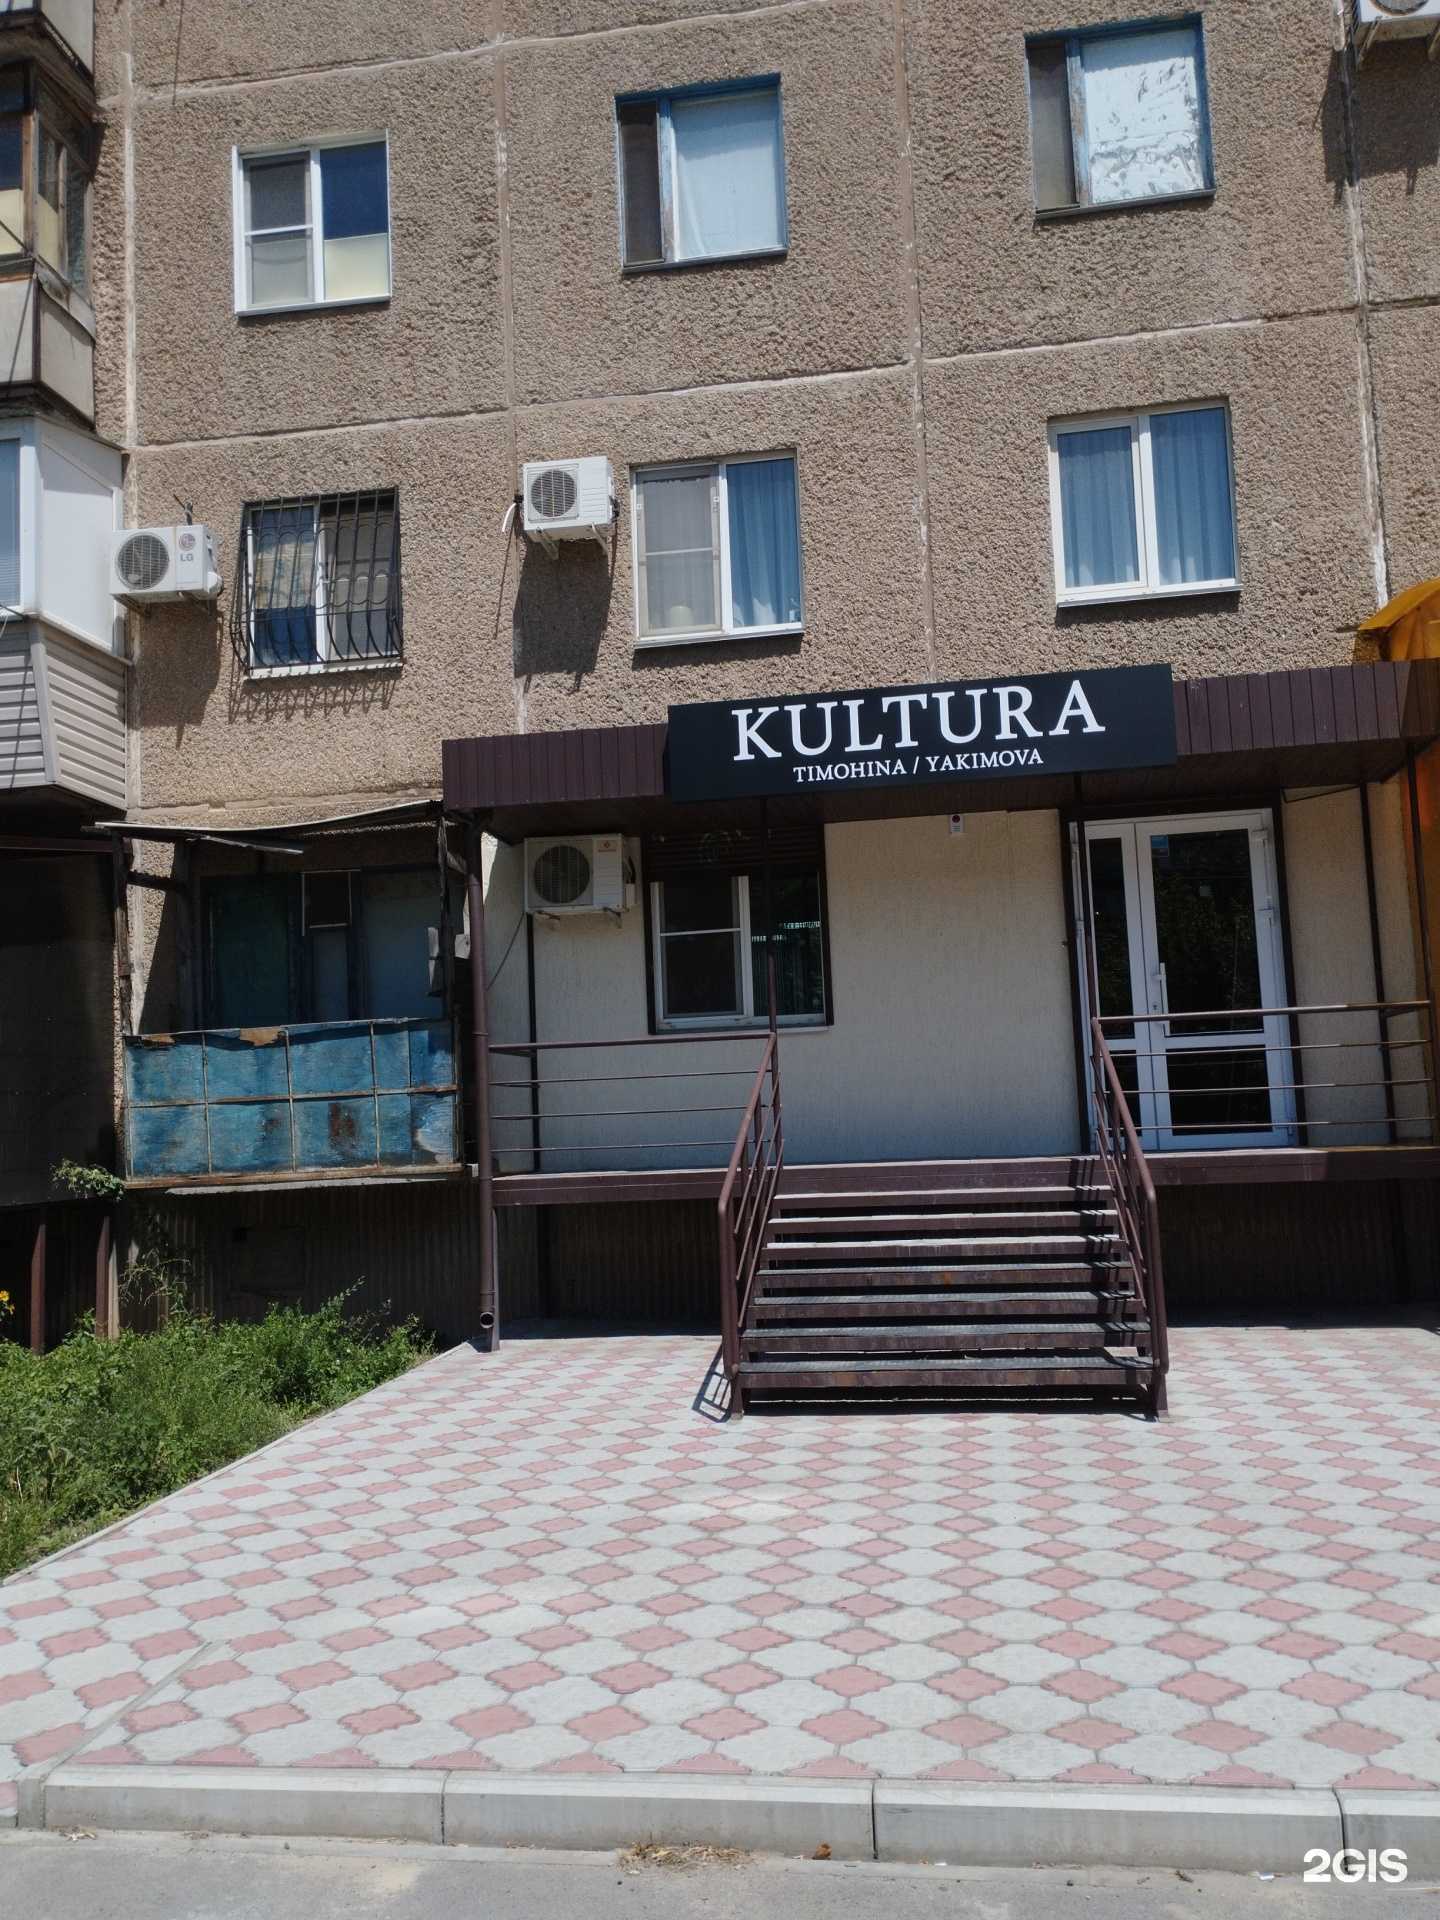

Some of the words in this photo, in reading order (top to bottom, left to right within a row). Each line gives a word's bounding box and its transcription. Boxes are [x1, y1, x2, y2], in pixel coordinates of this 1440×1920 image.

[180, 553, 194, 562] LG
[731, 680, 1105, 761] KULTURA
[793, 758, 907, 782] TIMOHINA
[913, 756, 919, 774] /
[925, 748, 1043, 772] YAKIMOVA
